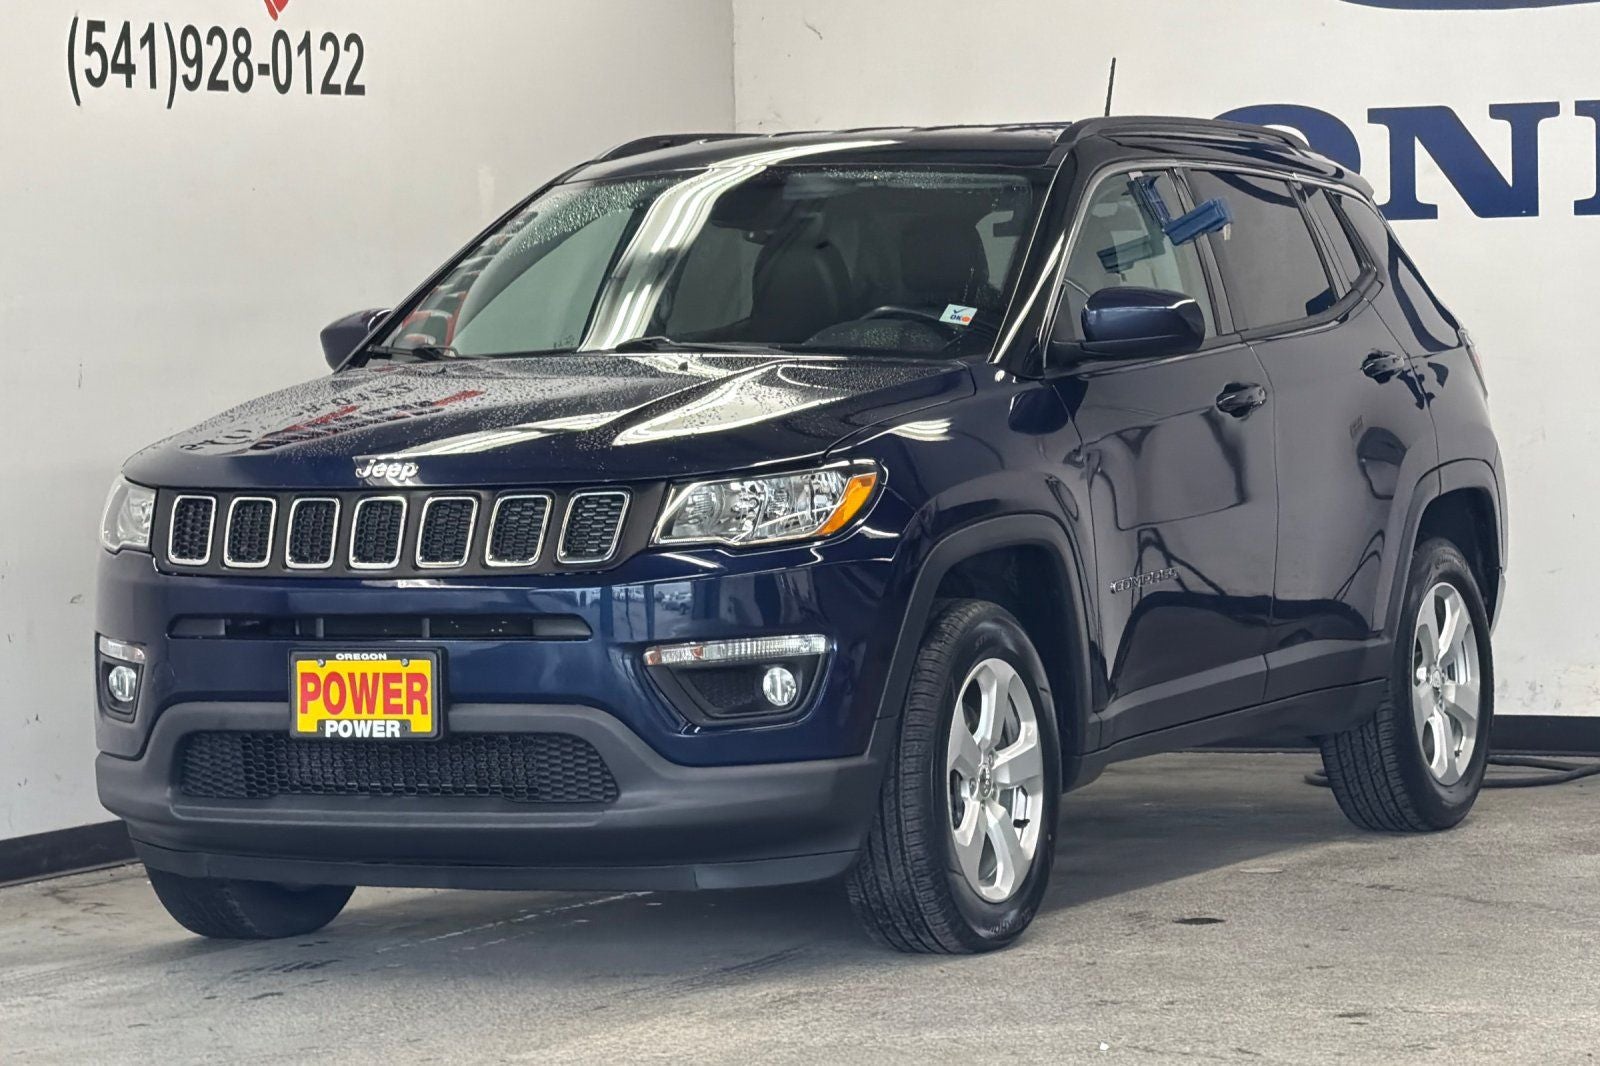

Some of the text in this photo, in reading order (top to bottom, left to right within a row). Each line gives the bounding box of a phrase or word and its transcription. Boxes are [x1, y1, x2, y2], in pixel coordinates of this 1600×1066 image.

[67, 15, 366, 109] (541)928-0122
[355, 459, 419, 481] Jeep
[335, 652, 388, 661] OREGON
[300, 671, 429, 716] POWER
[324, 719, 401, 739] POWER
